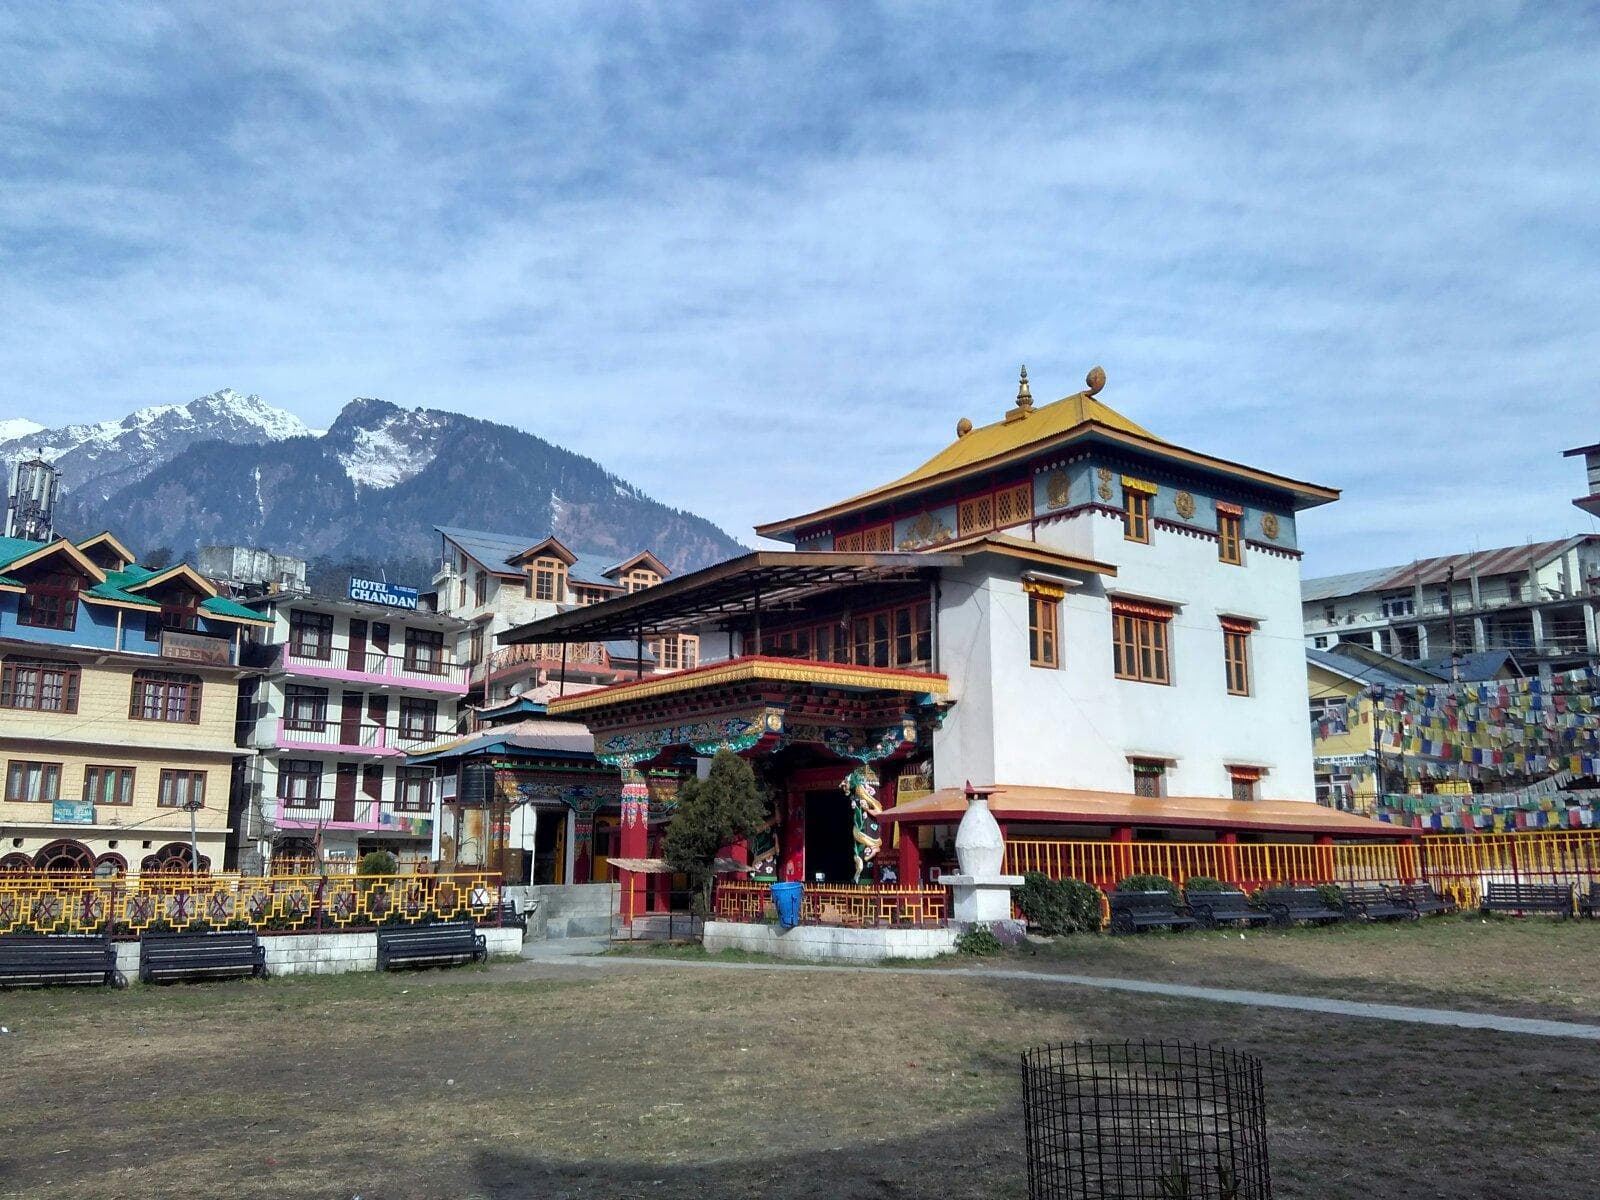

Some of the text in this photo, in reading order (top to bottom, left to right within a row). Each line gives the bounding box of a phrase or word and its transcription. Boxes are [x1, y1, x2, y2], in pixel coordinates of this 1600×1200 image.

[352, 578, 388, 593] HOTEL
[351, 588, 417, 609] CHANDAN
[164, 647, 228, 667] HEENA
